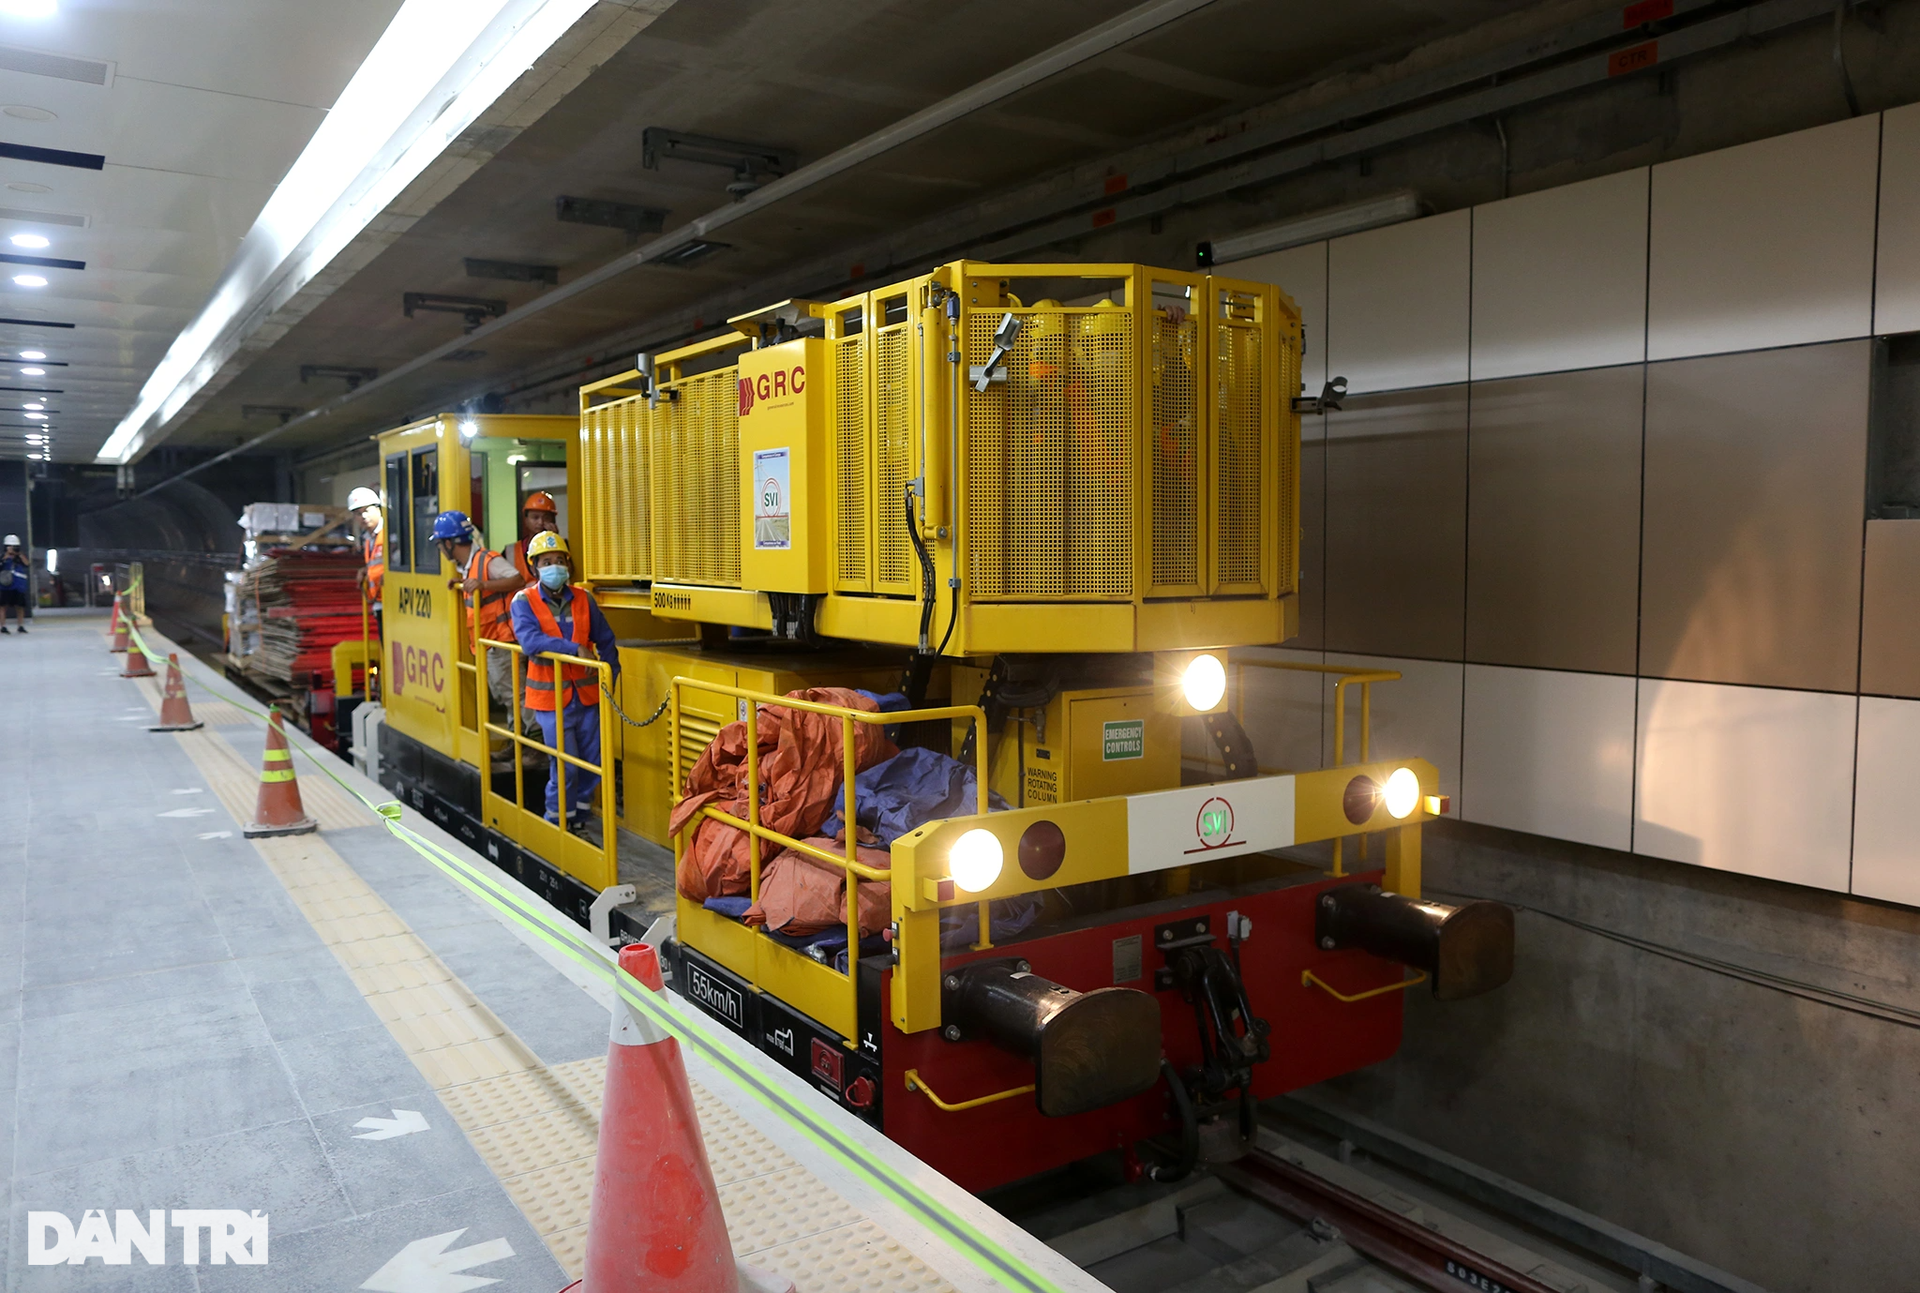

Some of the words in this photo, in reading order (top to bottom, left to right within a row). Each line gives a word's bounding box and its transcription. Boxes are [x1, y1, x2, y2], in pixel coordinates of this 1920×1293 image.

[1619, 50, 1647, 67] CTR
[757, 365, 806, 401] GRC
[764, 492, 778, 507] SVI
[398, 586, 415, 615] APV
[415, 588, 432, 619] 220
[405, 645, 444, 693] GRC
[1105, 727, 1142, 740] EMERGENCY
[1106, 741, 1140, 753] CONTROLS
[1027, 767, 1057, 781] WARNING
[1027, 778, 1057, 793] ROTATING
[1027, 789, 1058, 804] COLUMN
[1203, 810, 1227, 837] SVI
[692, 971, 737, 1020] 55km/h
